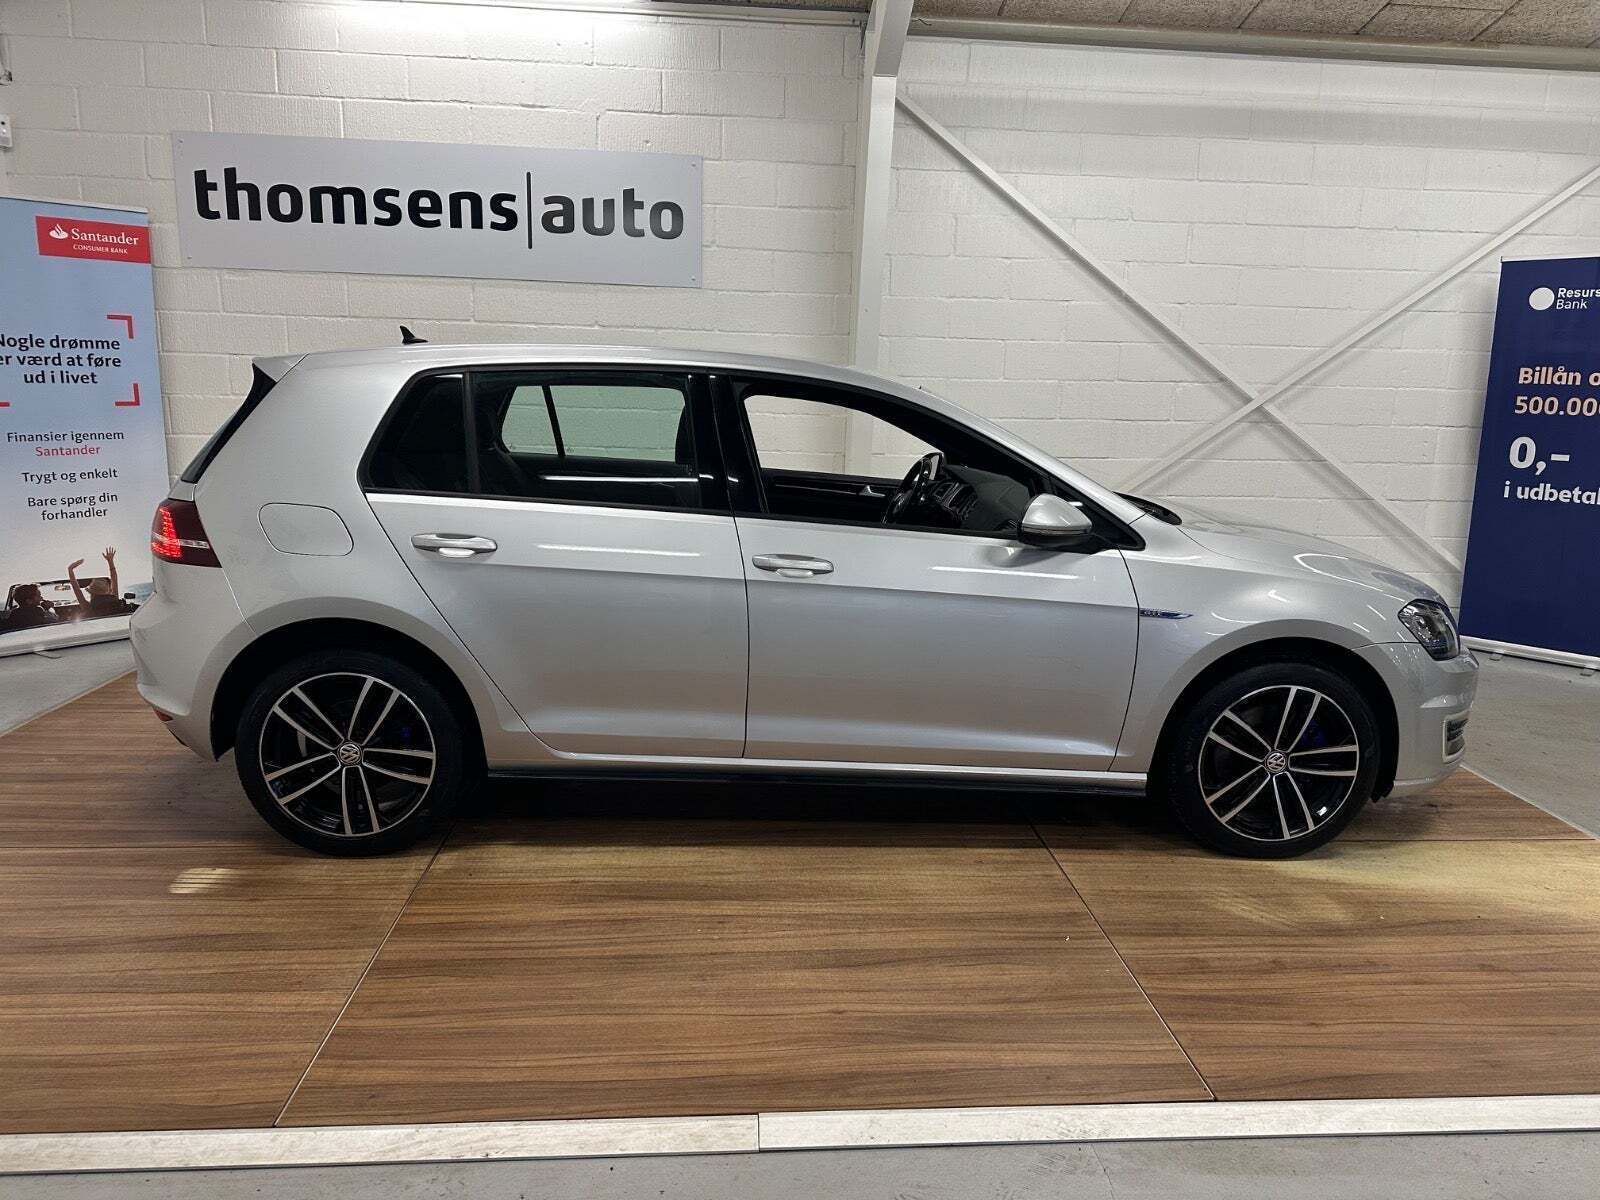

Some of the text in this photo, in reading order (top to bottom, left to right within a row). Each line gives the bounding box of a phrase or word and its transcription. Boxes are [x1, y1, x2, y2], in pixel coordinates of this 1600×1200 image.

[194, 166, 685, 240] thomsens auto
[71, 227, 139, 245] Santander
[73, 244, 109, 252] CONSUMER
[1558, 287, 1600, 298] Resurs
[1556, 299, 1588, 310] Bank
[50, 334, 121, 350] drømme
[16, 352, 62, 366] værd
[66, 354, 84, 367] at
[87, 353, 121, 367] føre
[24, 370, 98, 384] ud i livet
[1518, 365, 1582, 385] Billån
[1514, 395, 1600, 417] 500.00
[7, 431, 125, 443] Finansier igennem
[35, 445, 101, 456] Santander
[22, 468, 118, 484] Trygt og enkelt
[1503, 480, 1511, 498] i
[28, 493, 118, 507] Bare spørg din
[41, 508, 108, 520] forhandler
